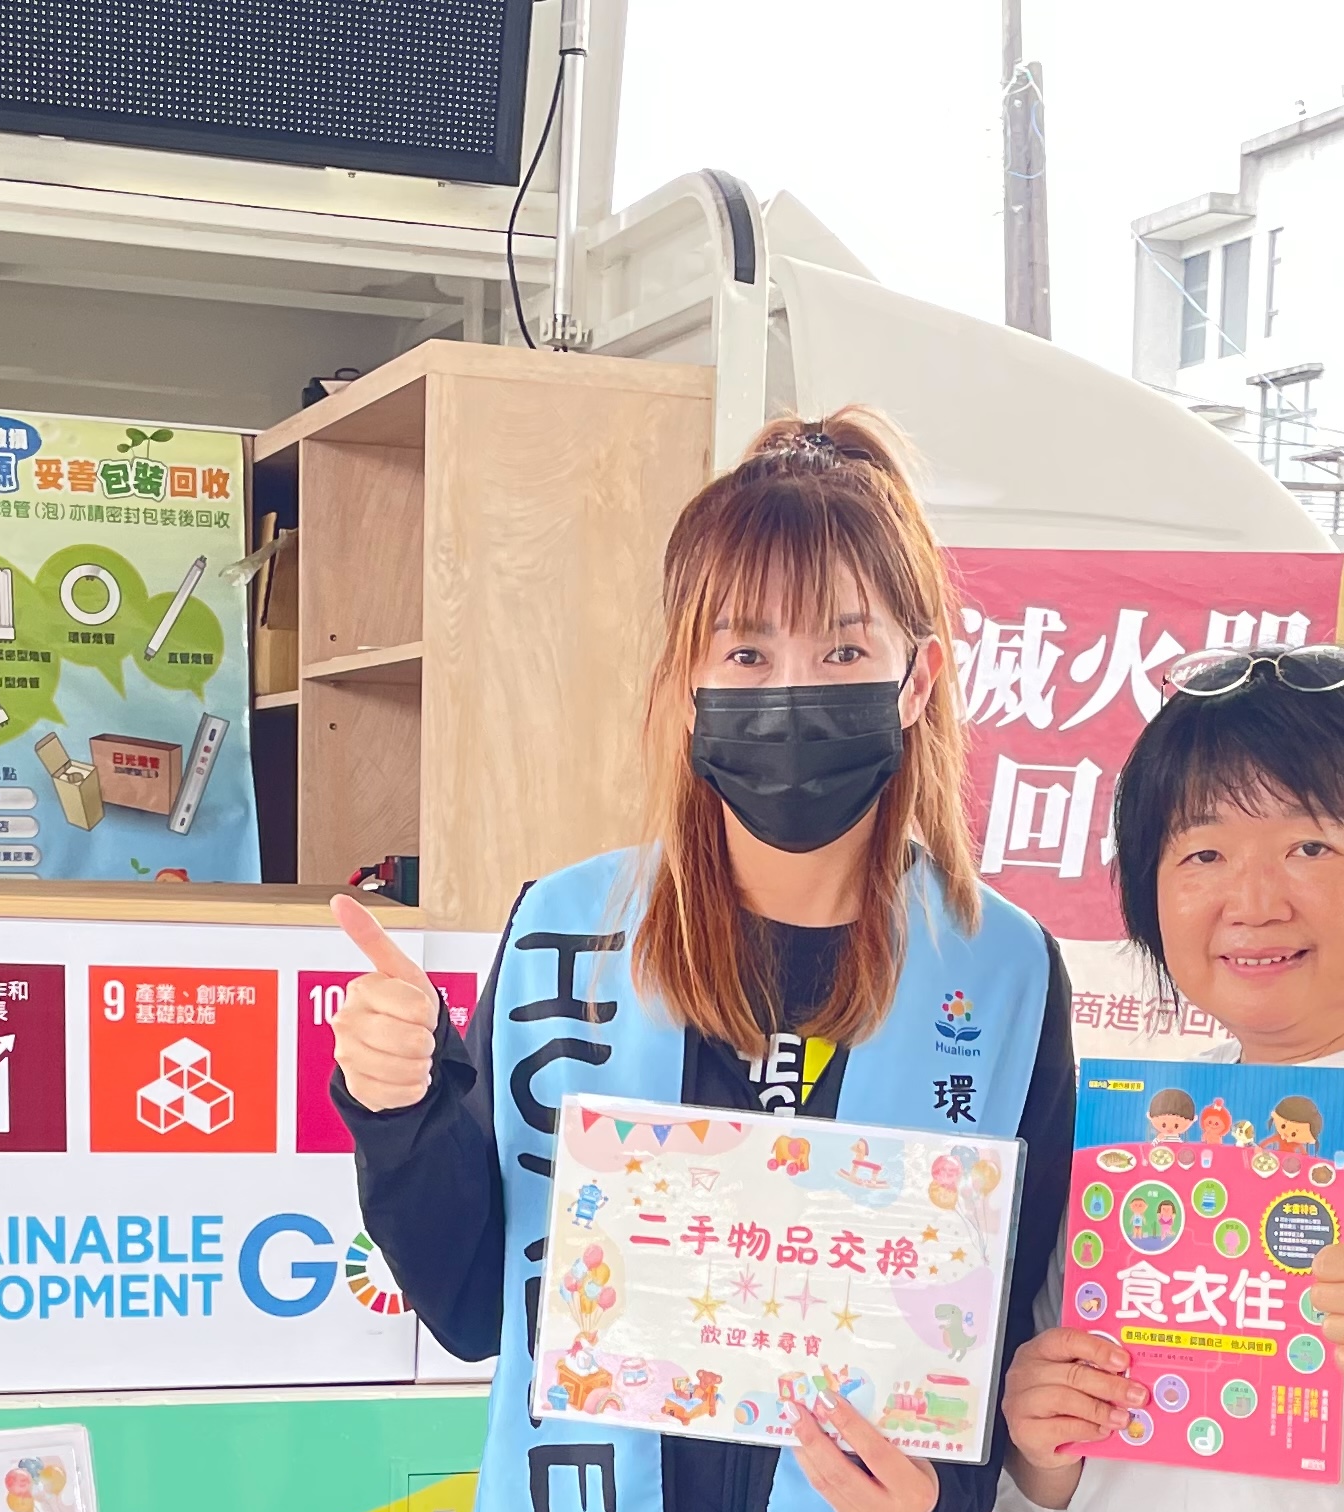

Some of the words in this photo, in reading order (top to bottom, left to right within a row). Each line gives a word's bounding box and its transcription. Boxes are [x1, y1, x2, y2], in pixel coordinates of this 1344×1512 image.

[35, 458, 231, 499] 妥善包裝回收
[104, 980, 125, 1022] 9
[136, 984, 256, 1005] 產業、創新和
[136, 1005, 216, 1025] 基礎設施
[935, 1041, 980, 1057] Hualien
[630, 1213, 919, 1279] 二手物品交換
[1115, 1260, 1286, 1331] 食衣住
[700, 1325, 823, 1358] 歡迎來尋寶
